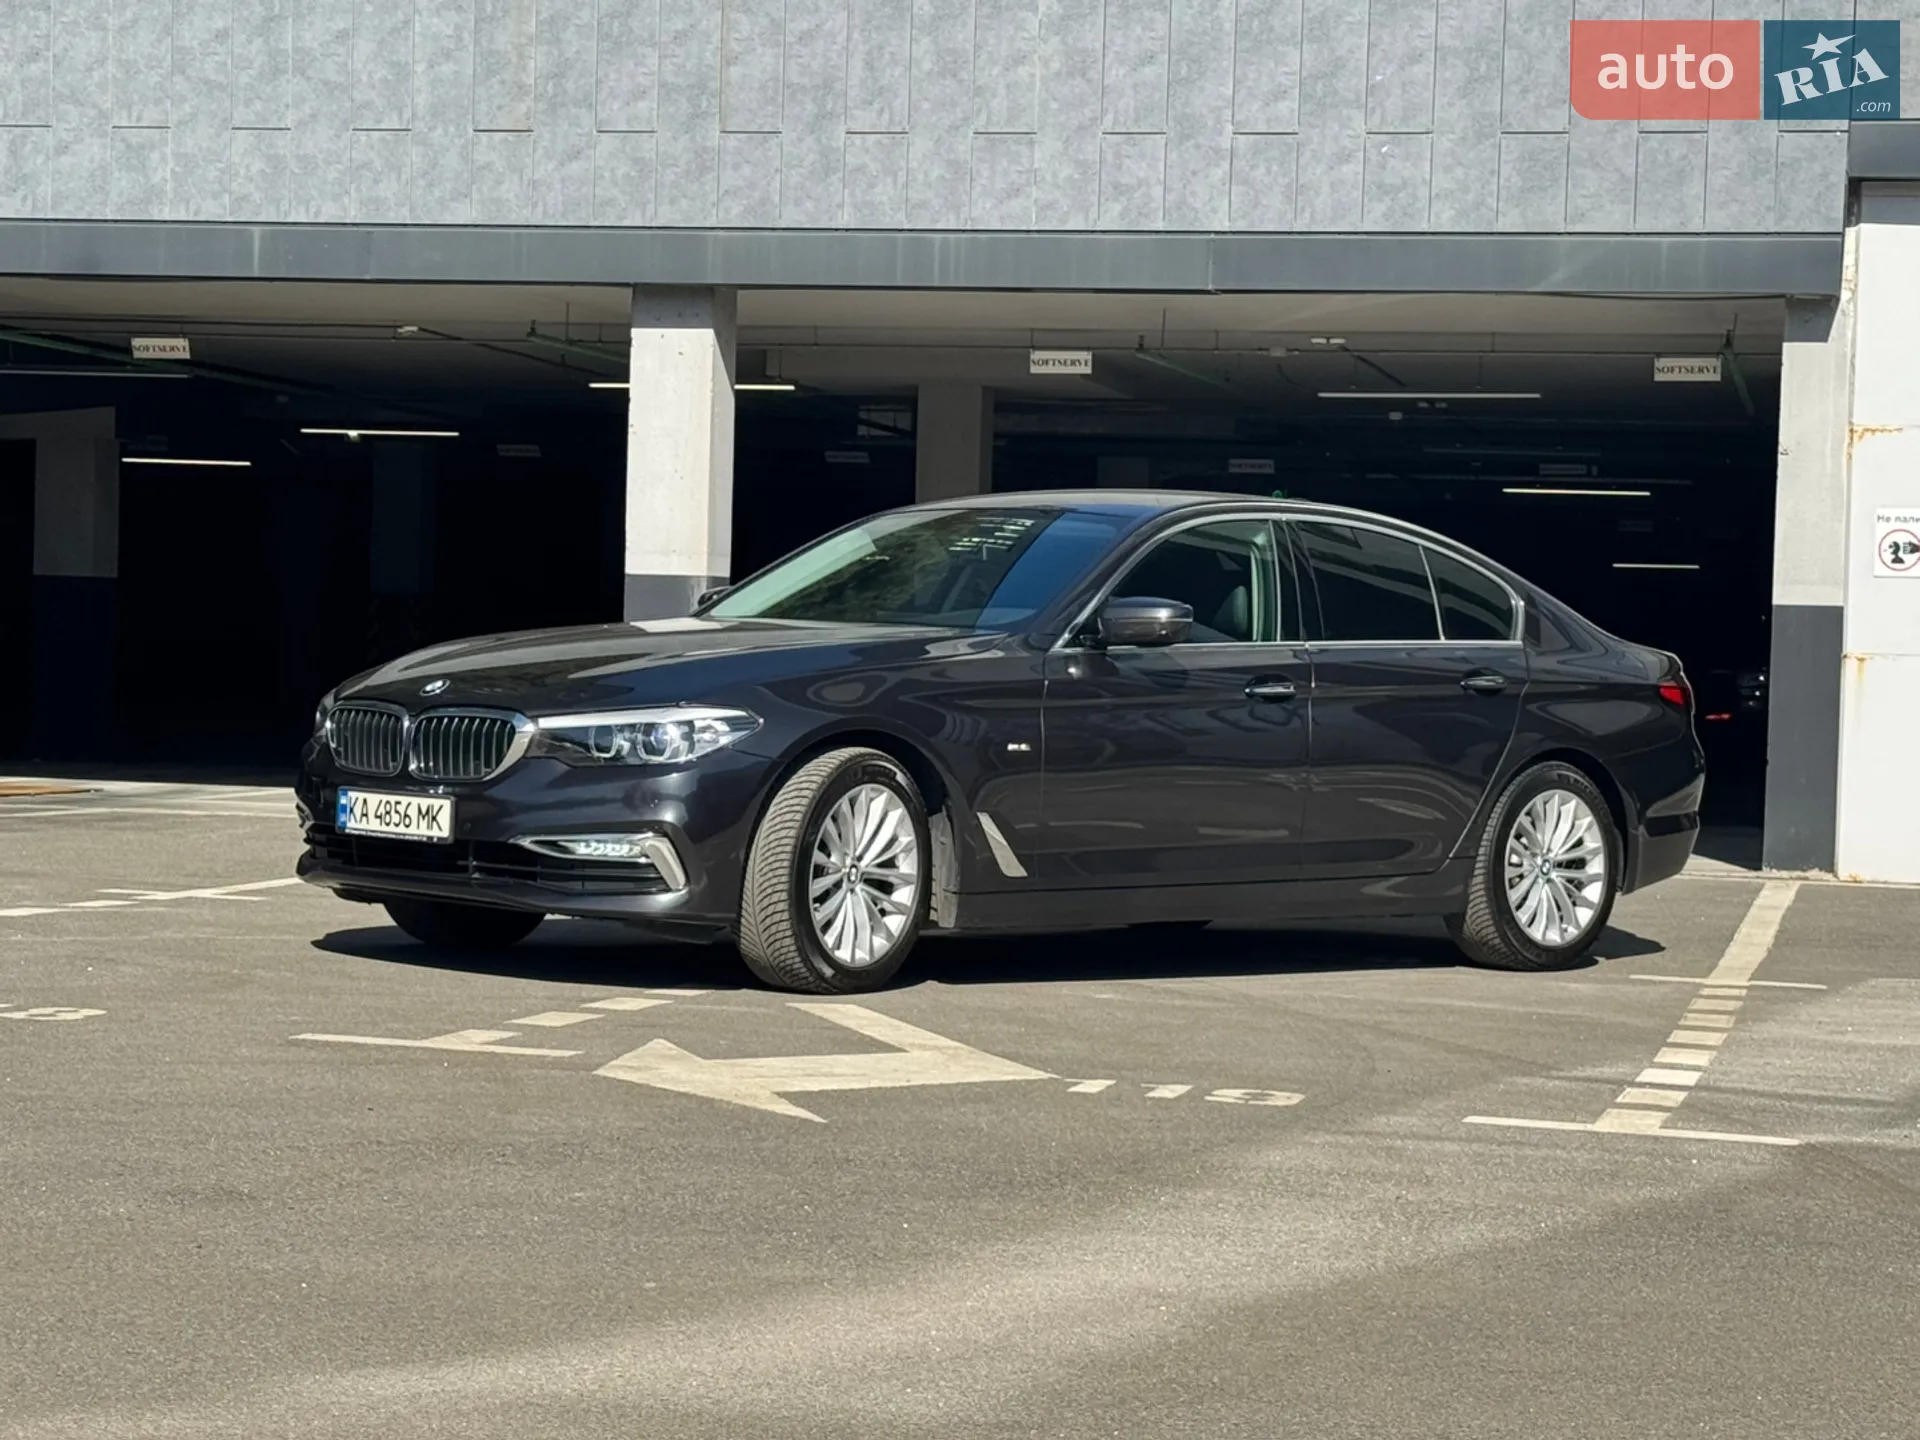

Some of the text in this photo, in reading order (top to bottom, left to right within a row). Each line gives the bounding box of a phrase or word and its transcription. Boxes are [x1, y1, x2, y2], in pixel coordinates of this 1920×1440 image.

[1031, 357, 1090, 368] SOFTSERVE
[1655, 364, 1719, 375] SOFTSERVE
[1877, 514, 1892, 523] Не
[348, 796, 444, 832] KA 4856 MK
